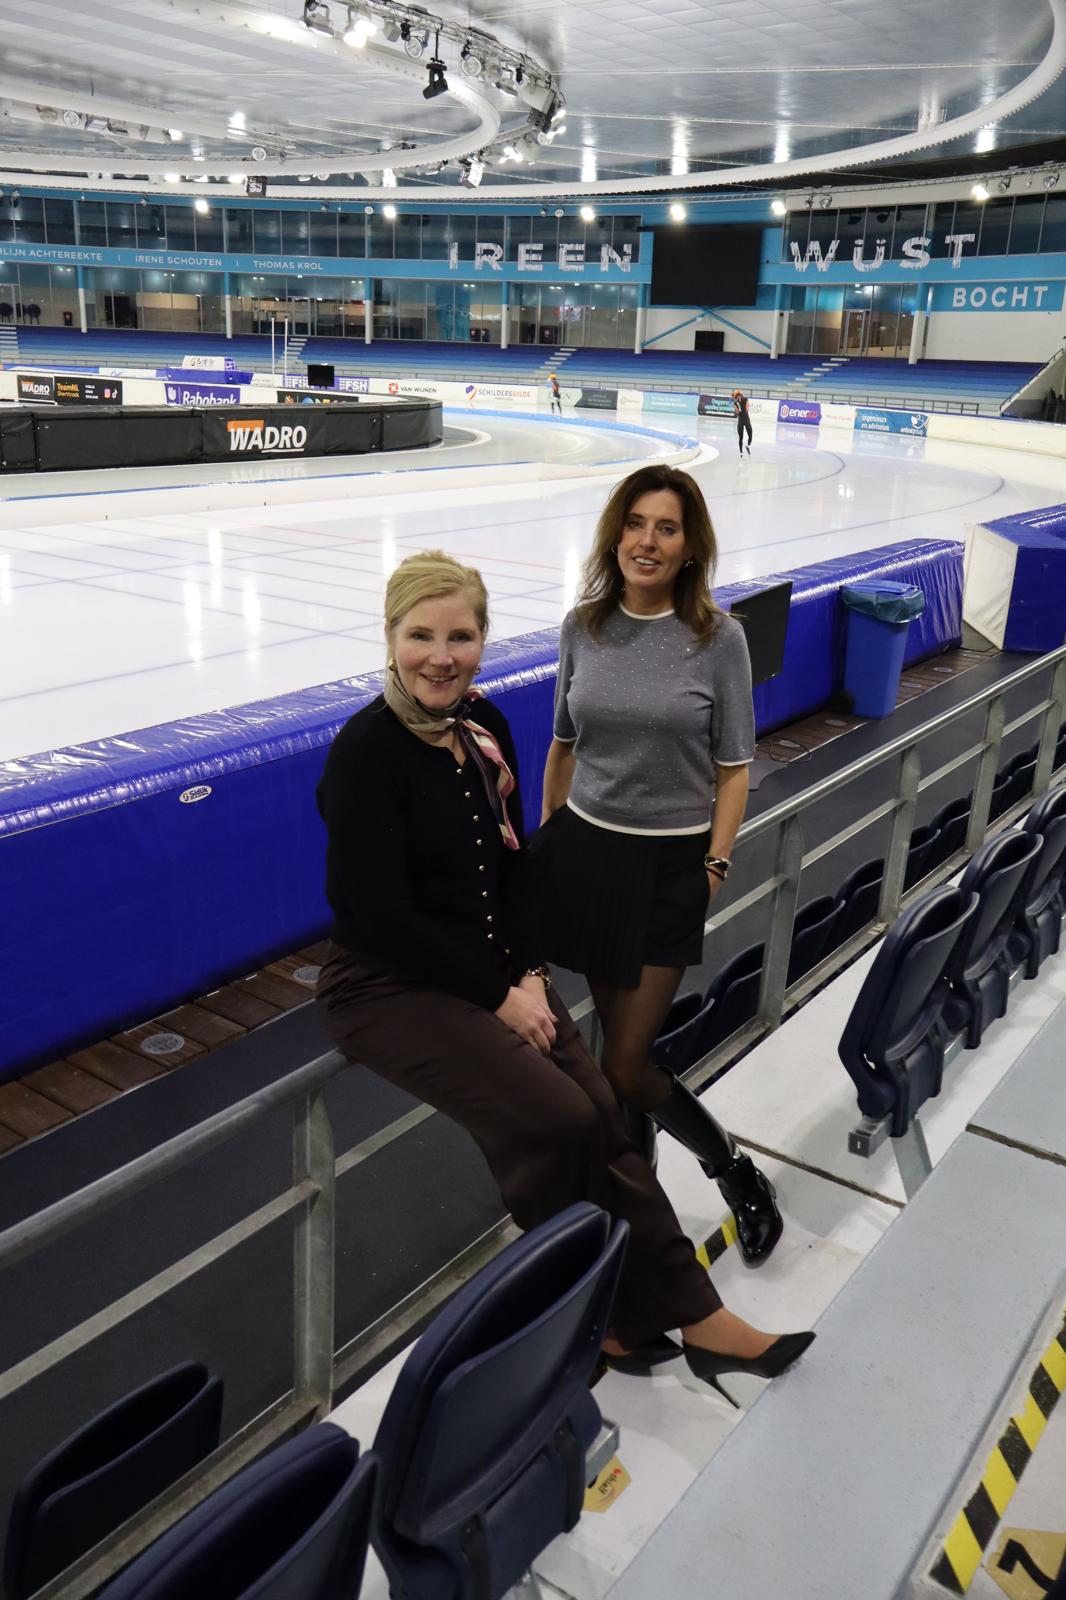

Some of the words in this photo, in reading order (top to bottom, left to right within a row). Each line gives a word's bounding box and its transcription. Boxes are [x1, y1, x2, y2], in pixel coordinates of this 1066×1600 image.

[29, 249, 103, 261] ACHTEREEKTE
[135, 255, 165, 264] IRENE
[167, 257, 222, 267] SCHOUTEN
[448, 242, 633, 273] IREEN
[789, 233, 976, 272] WÜST
[253, 260, 295, 270] THOMAS
[297, 262, 324, 271] KROL
[952, 286, 1049, 308] BOCHT
[21, 383, 50, 394] WADRO
[182, 391, 238, 405] Rabobank
[229, 425, 307, 451] WADRO
[598, 1473, 617, 1495] thialf
